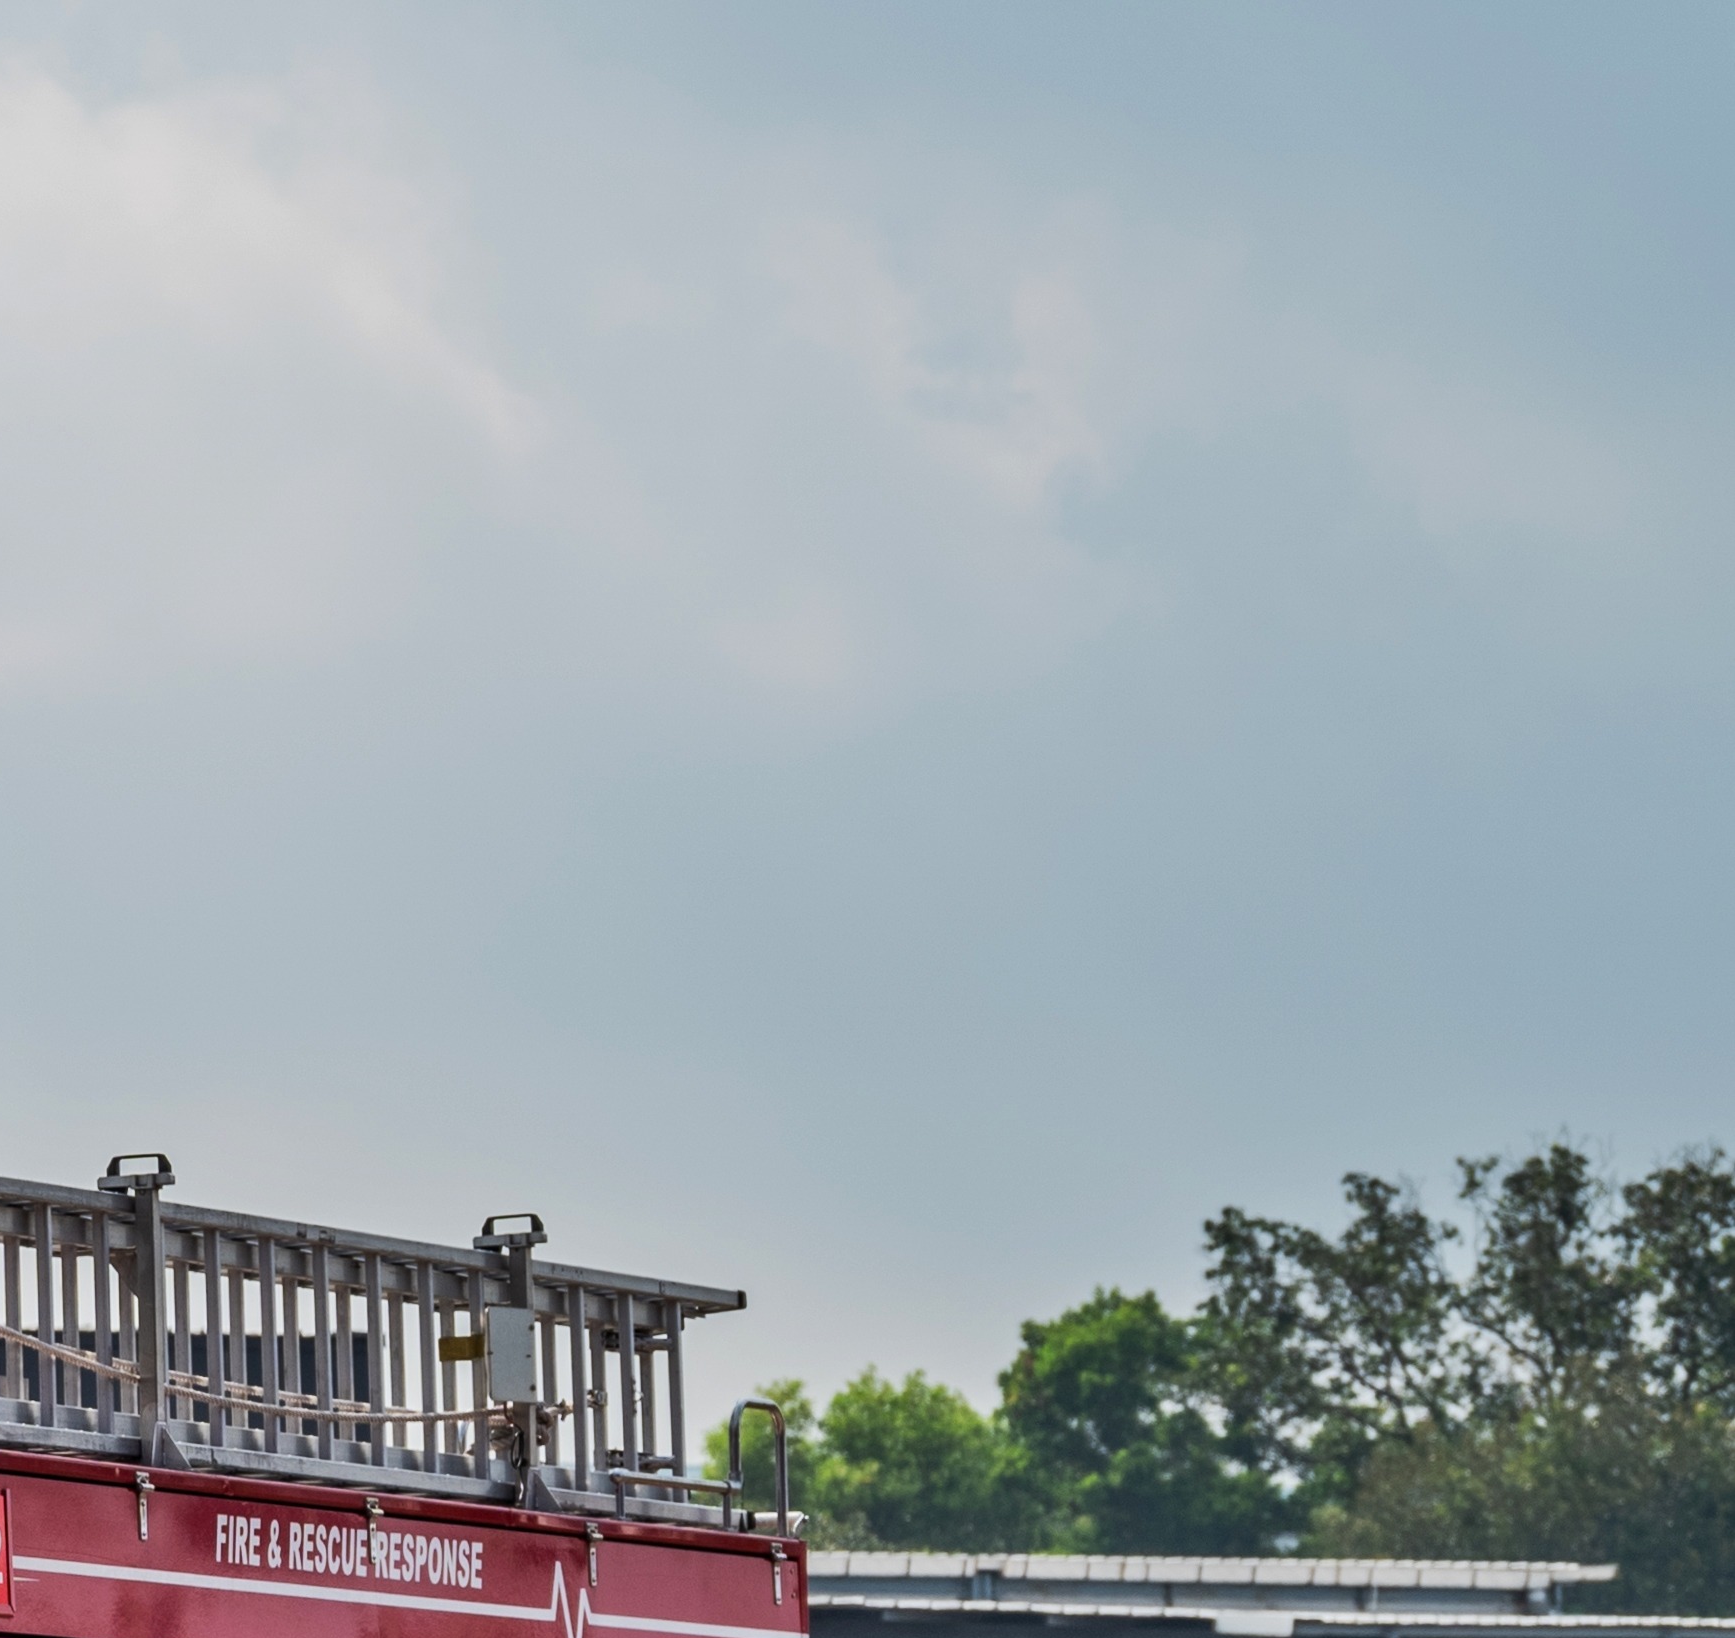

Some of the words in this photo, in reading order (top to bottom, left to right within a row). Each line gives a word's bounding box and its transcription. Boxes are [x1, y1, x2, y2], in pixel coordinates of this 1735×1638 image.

[216, 1513, 261, 1566] FIRE
[267, 1519, 281, 1568] &
[289, 1522, 367, 1577] RESCUE
[375, 1531, 483, 1590] RESPONSE
